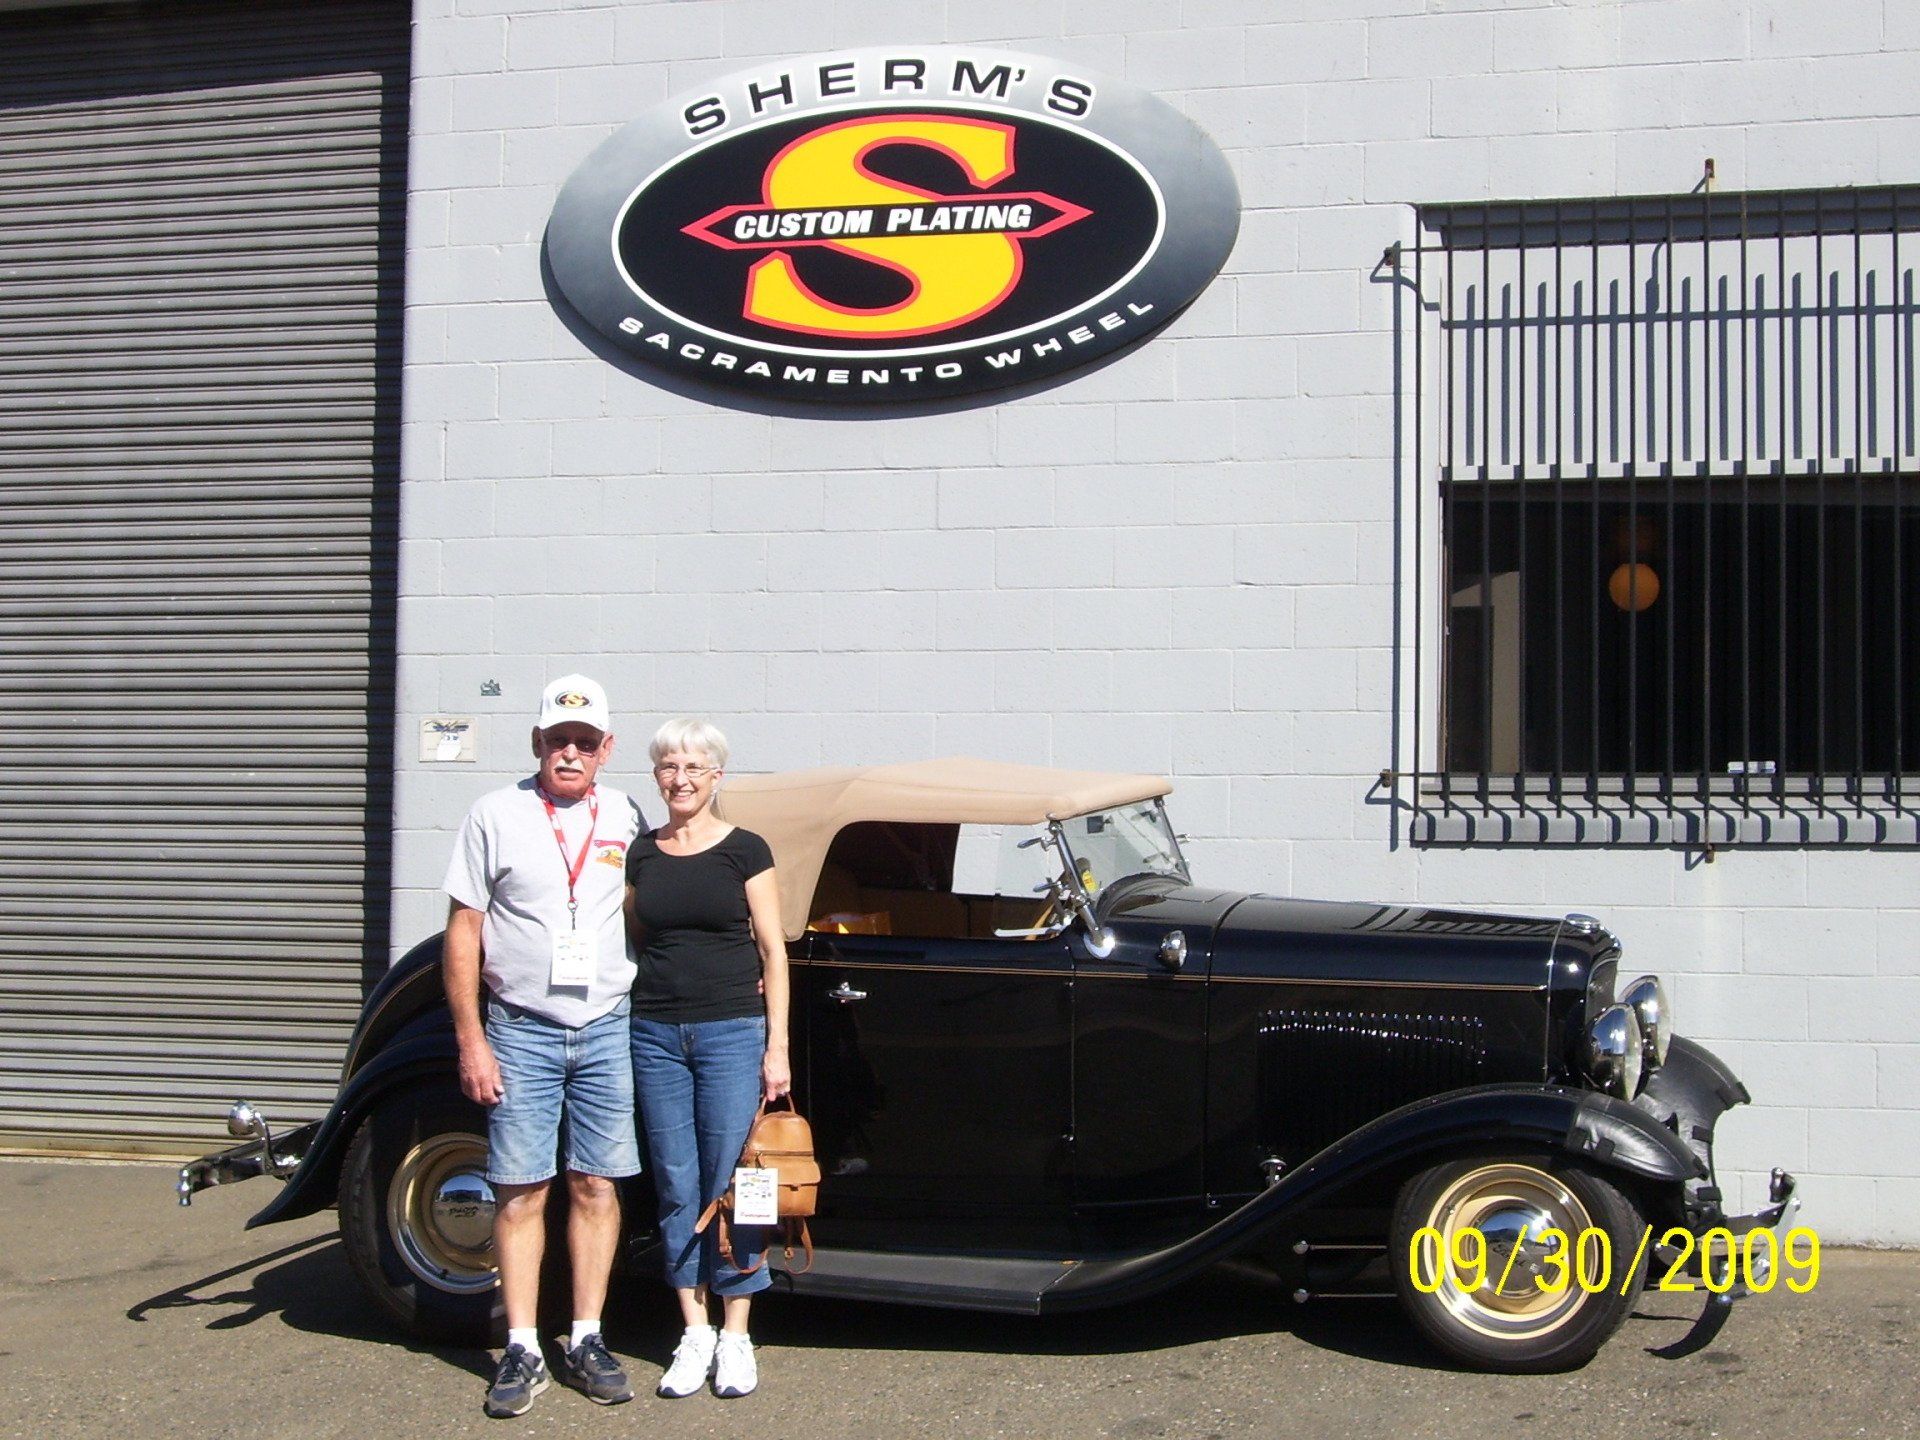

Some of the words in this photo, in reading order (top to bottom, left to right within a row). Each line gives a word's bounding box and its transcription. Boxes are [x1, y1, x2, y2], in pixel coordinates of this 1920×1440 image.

[684, 59, 1093, 135] SHERM'S
[734, 209, 872, 241] CUSTOM
[886, 204, 1032, 233] PLATING
[618, 316, 963, 384] SACRAMENTO
[984, 302, 1154, 368] WHEEL
